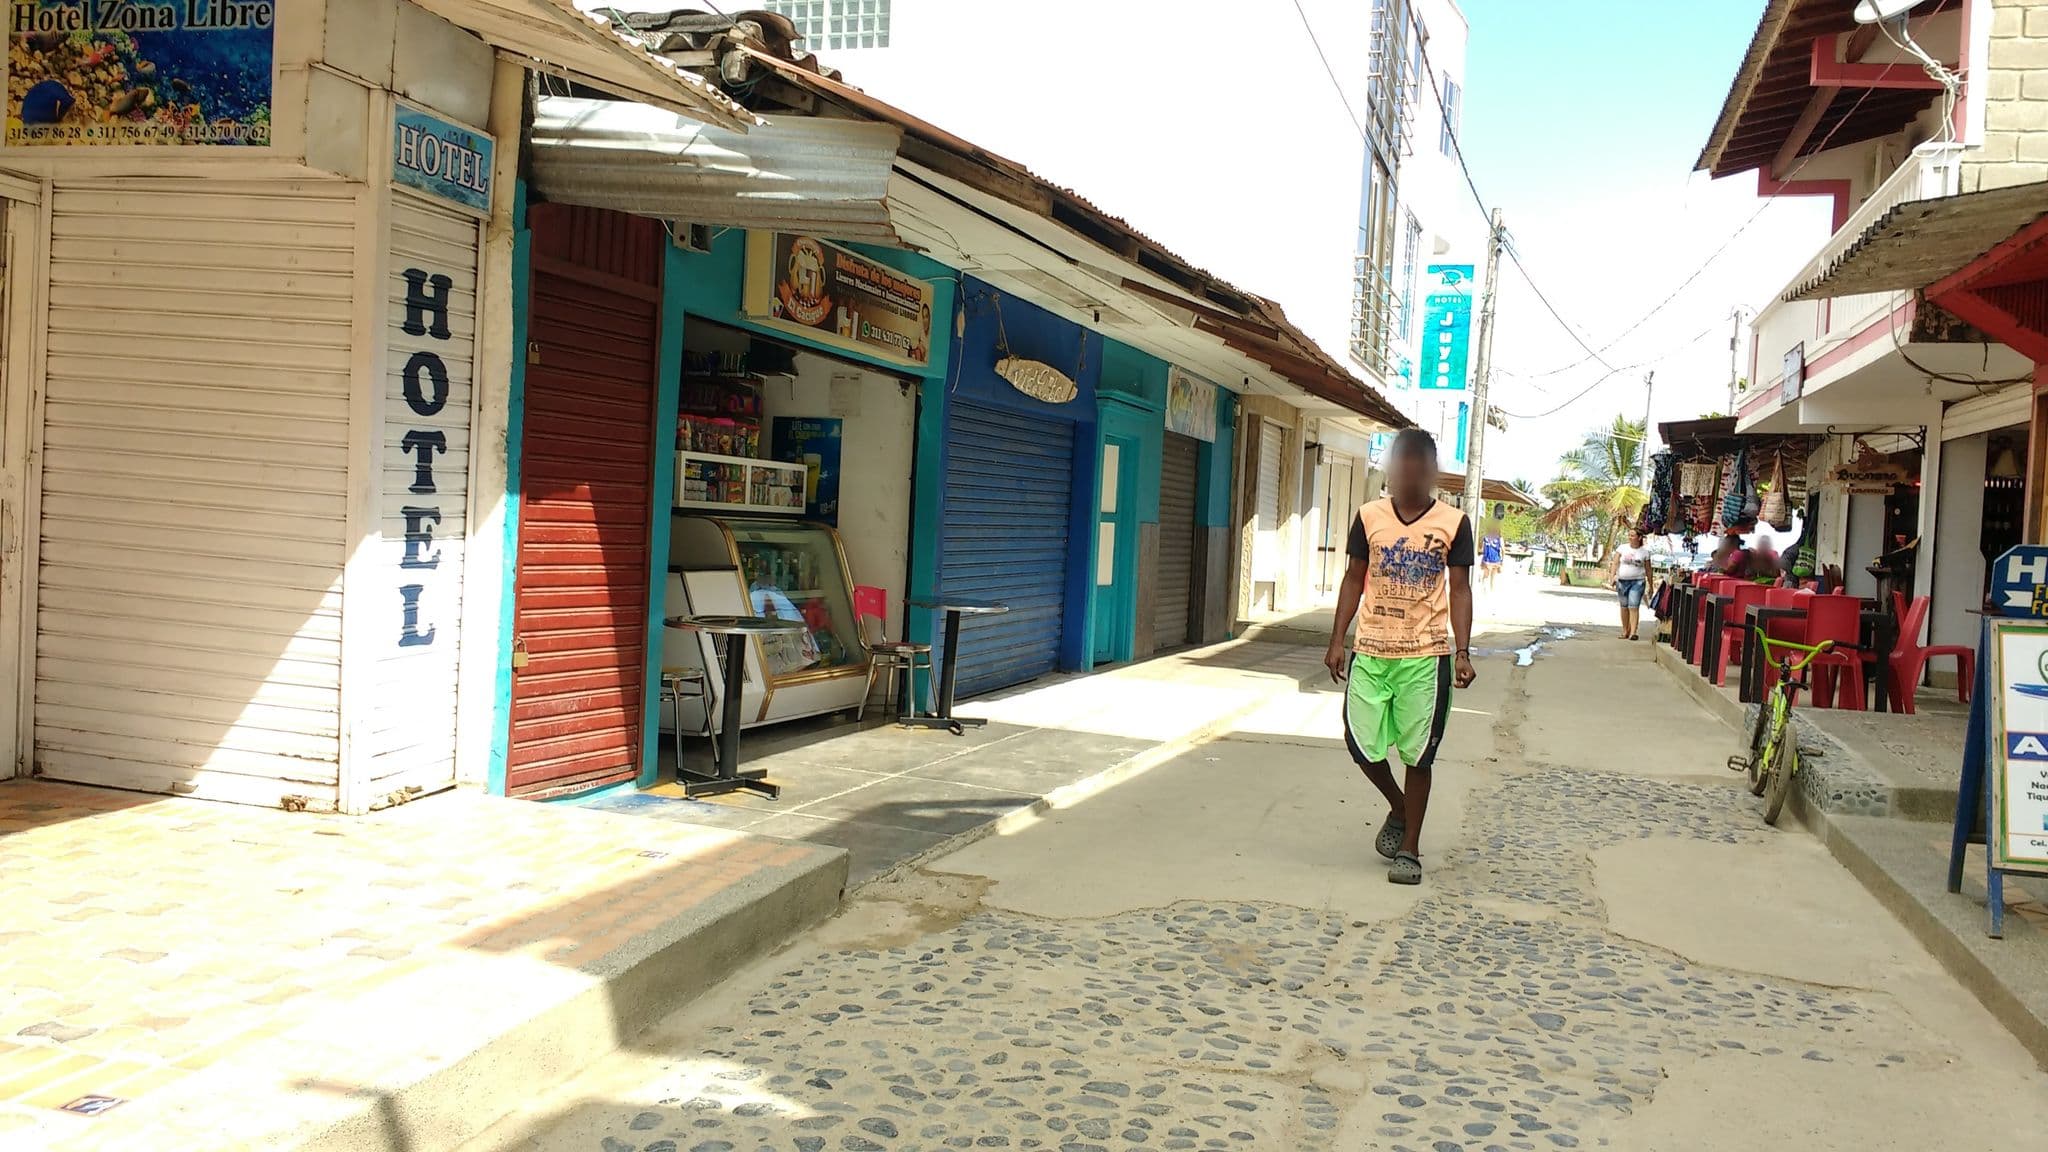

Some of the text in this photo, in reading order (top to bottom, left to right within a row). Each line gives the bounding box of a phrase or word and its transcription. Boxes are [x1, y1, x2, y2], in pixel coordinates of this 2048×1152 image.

[14, 0, 272, 32] Hotel Zona Libre
[9, 126, 265, 139] 315 657 86 28 311 756 67 49 314 870 07 62
[397, 122, 488, 194] HOTEL
[1434, 297, 1462, 305] HOTEL
[399, 268, 453, 647] HOTEL
[1424, 533, 1446, 552] 12
[2007, 555, 2048, 584] H
